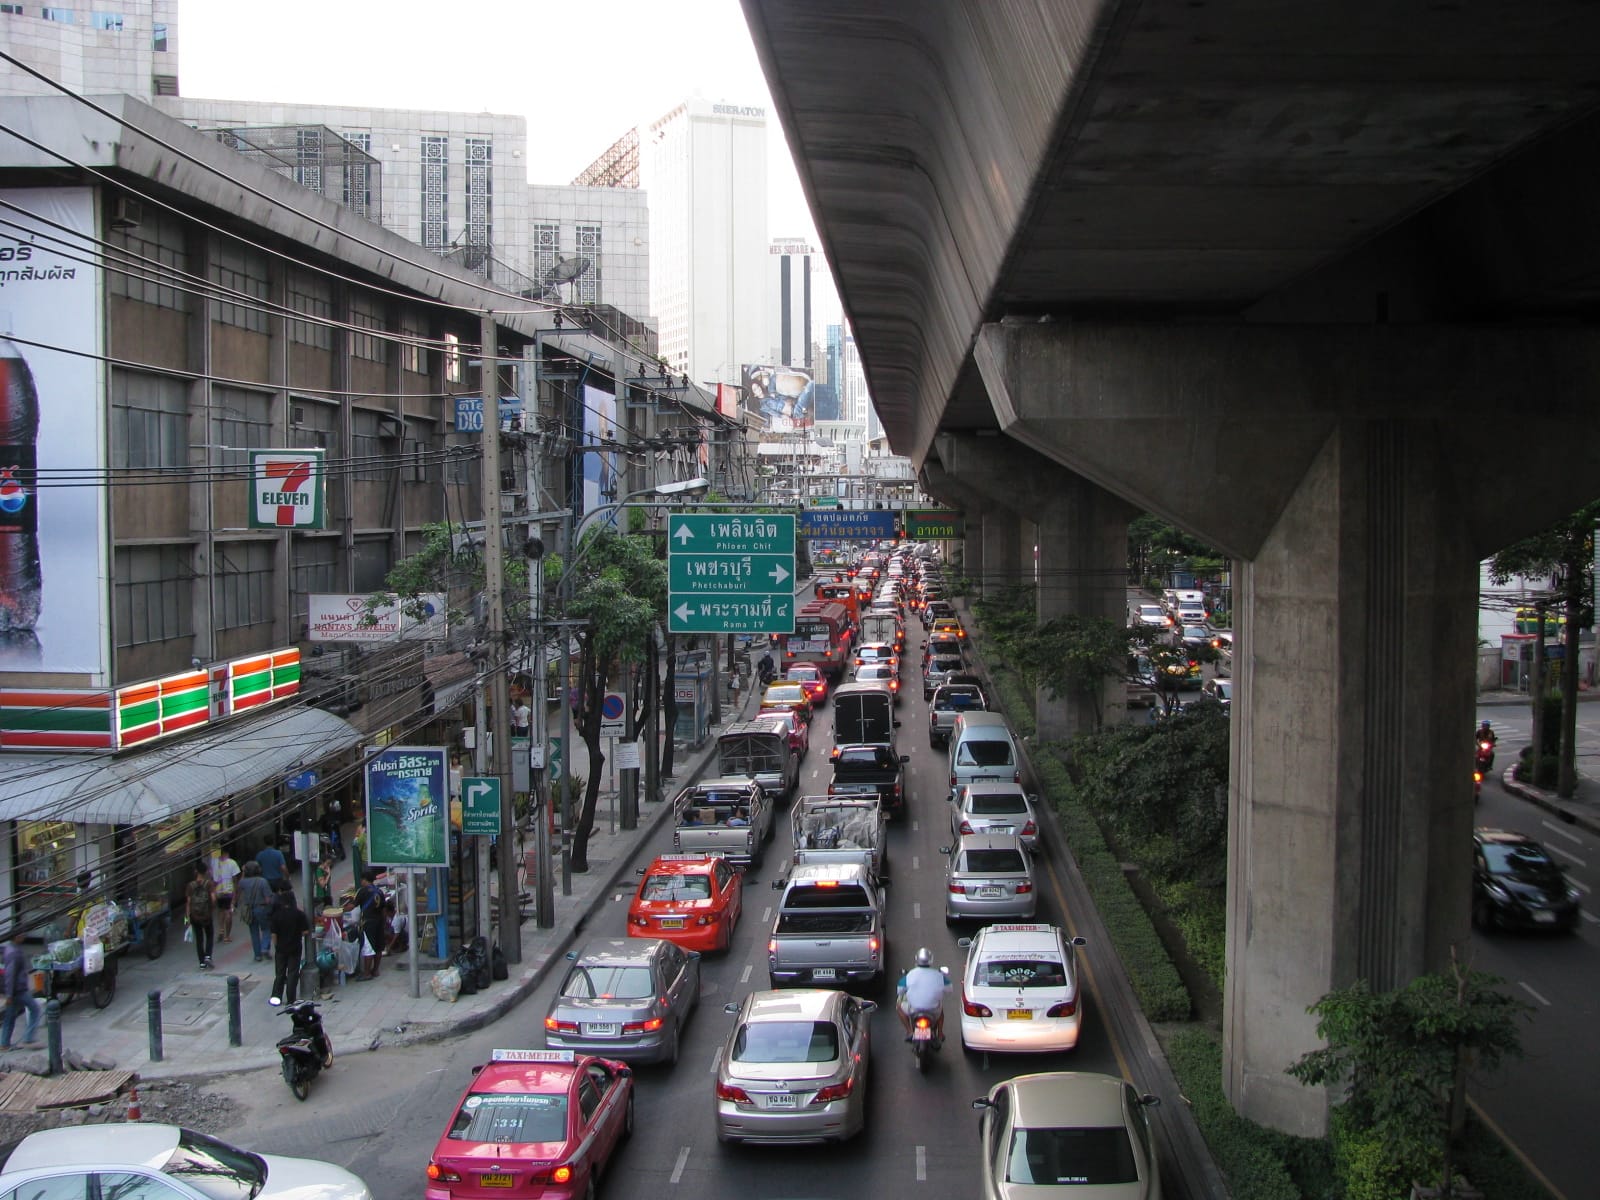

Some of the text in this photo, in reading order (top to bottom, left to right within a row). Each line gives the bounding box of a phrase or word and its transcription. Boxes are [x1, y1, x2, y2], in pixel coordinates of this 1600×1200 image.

[713, 104, 765, 117] SHERATON
[784, 245, 809, 255] SQUARE
[813, 511, 869, 522] เขตปลอดภัย
[710, 518, 777, 538] เพลินจิต
[716, 542, 771, 550] Phloen Chit
[687, 556, 752, 581] เพชรบุรี
[692, 581, 746, 589] Phetchaburi
[700, 594, 788, 617] พระรามที่ ๔
[314, 623, 353, 632] NANTA'S
[356, 623, 397, 633] JEWELRY
[407, 803, 438, 820] Sprite
[506, 1051, 560, 1060] TAXI-METER
